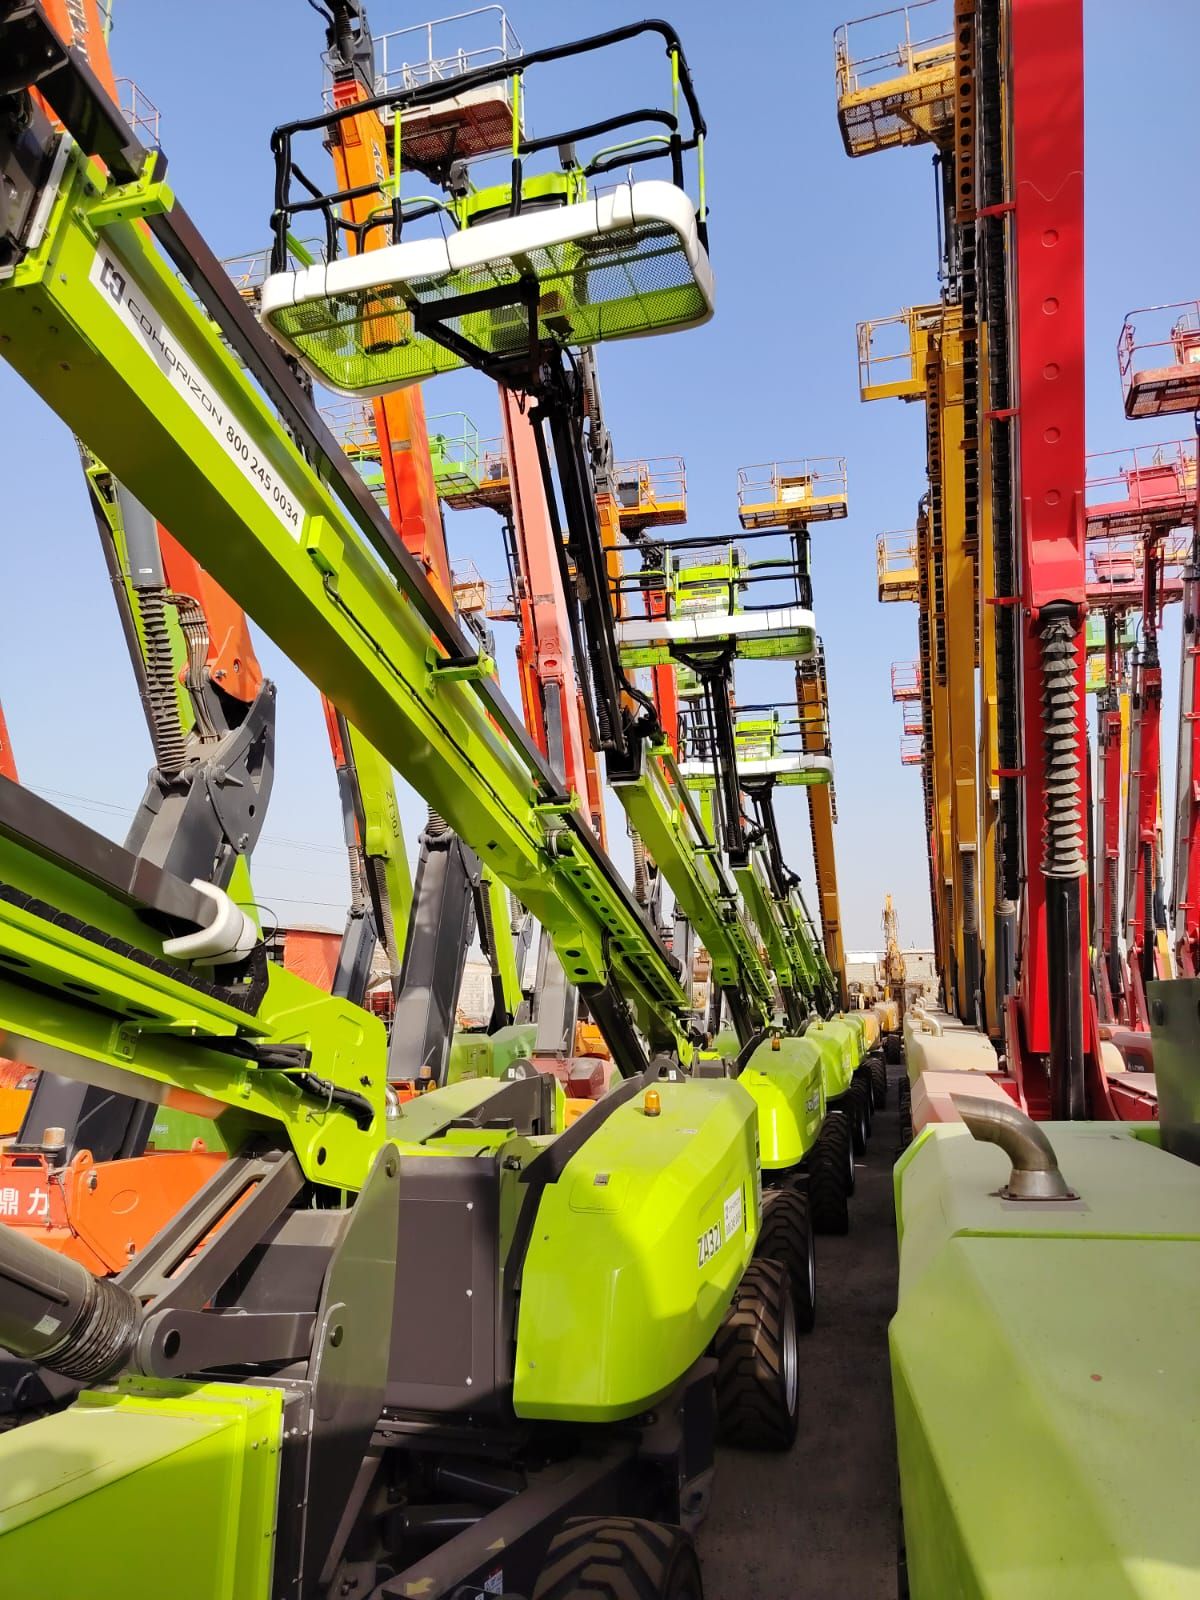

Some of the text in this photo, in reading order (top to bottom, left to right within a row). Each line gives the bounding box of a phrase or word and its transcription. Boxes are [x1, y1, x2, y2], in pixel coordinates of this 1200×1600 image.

[127, 298, 299, 527] COHORIZON 800 245 0034
[0, 1187, 49, 1216] 鼎力
